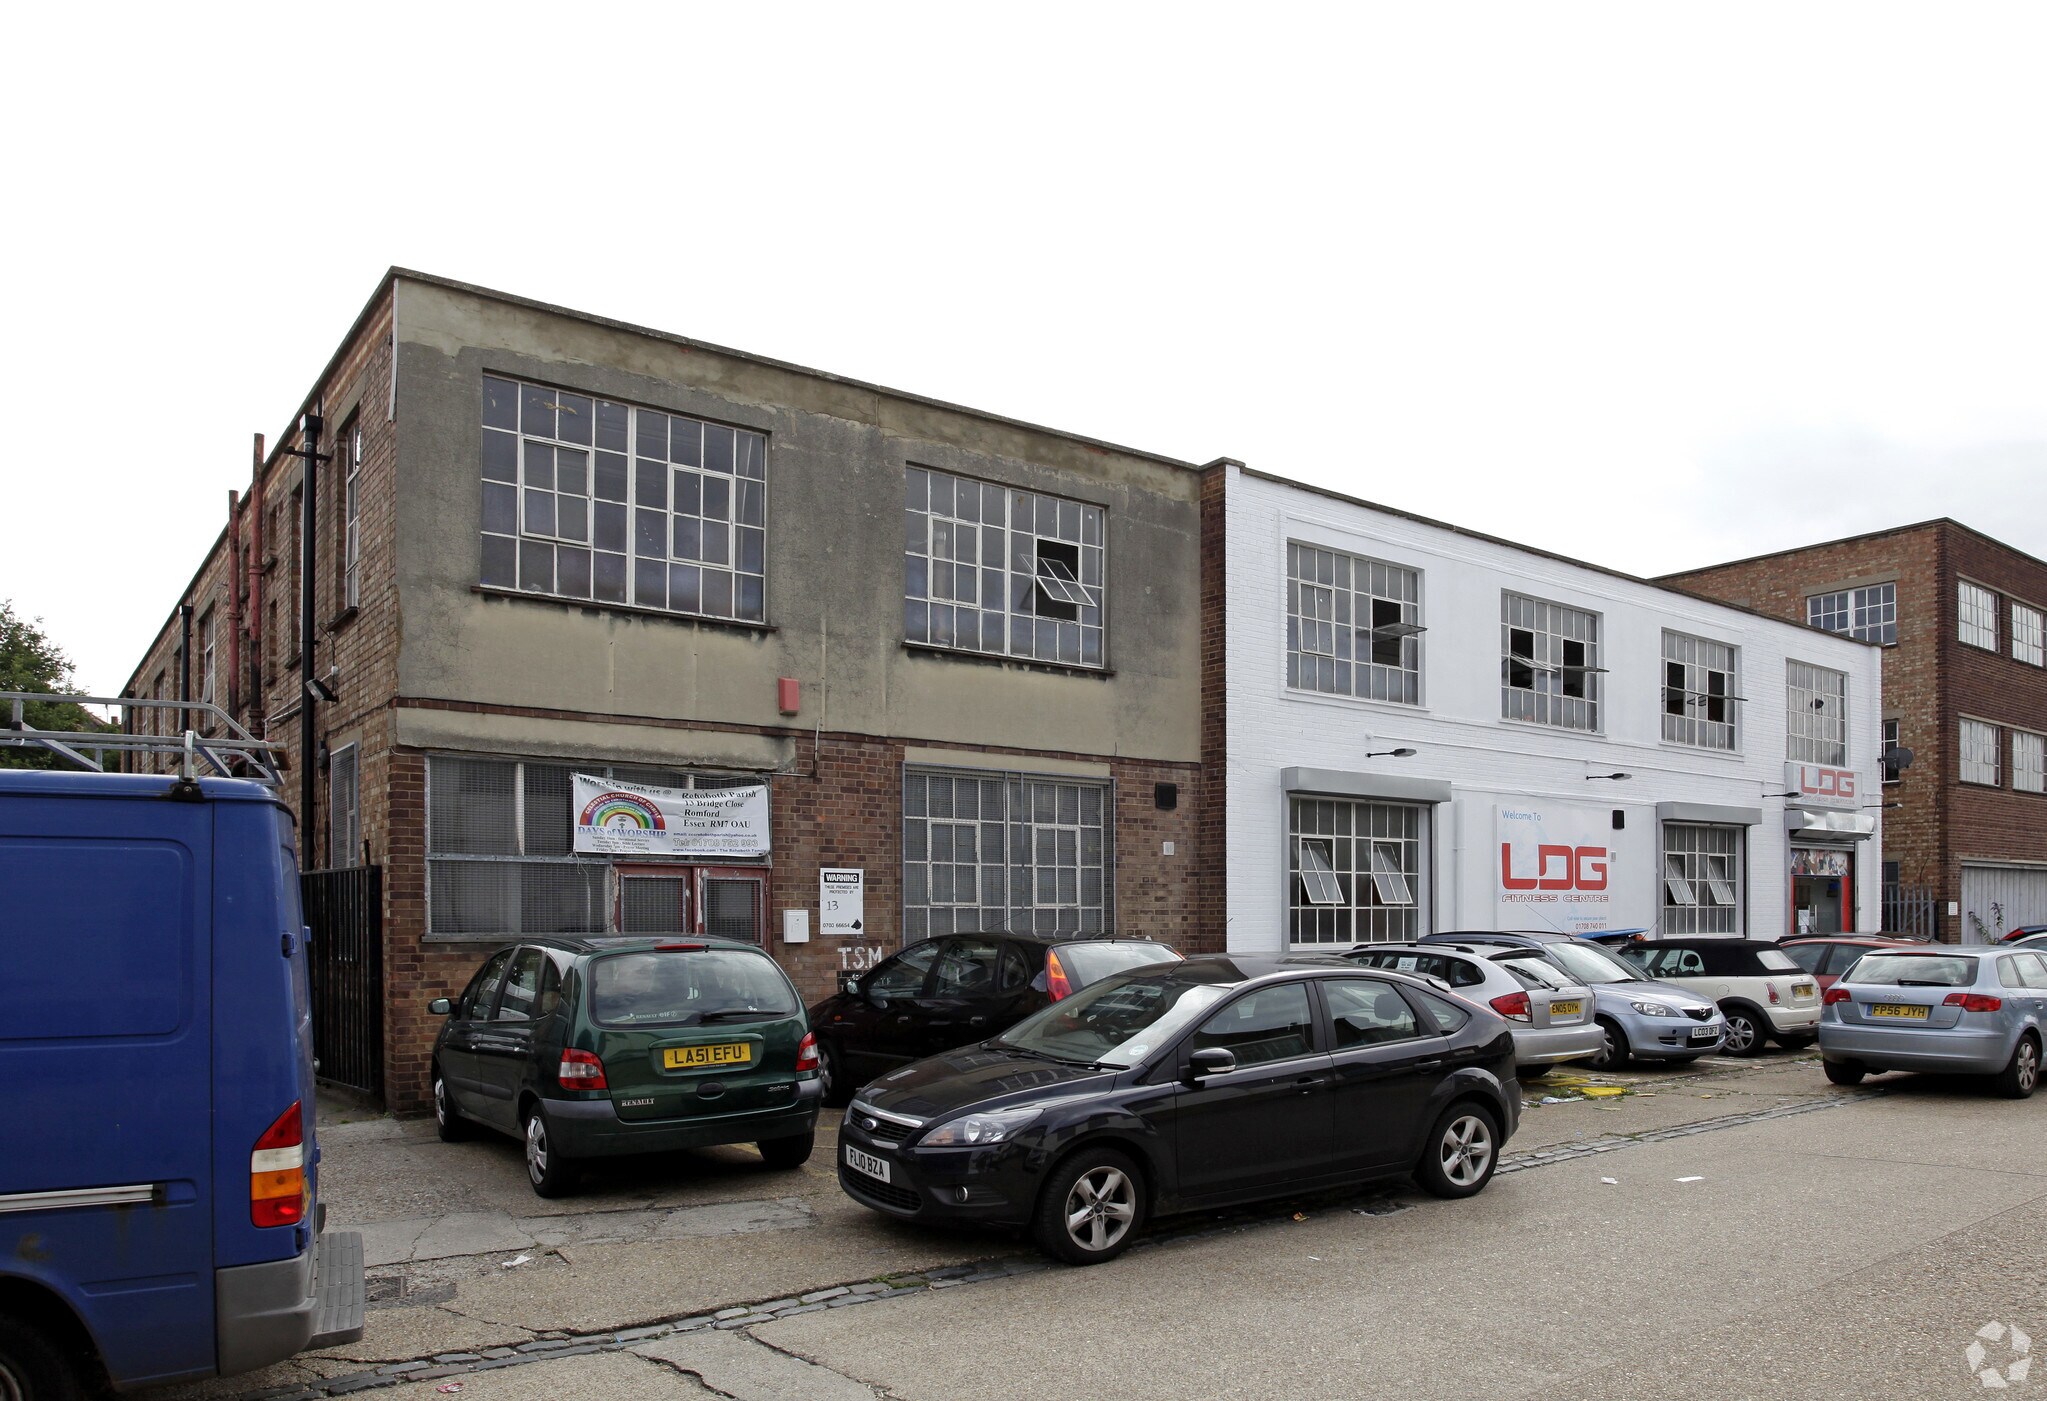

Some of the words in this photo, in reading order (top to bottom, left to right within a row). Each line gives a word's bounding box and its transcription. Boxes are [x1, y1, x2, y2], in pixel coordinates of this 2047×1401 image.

[580, 777, 622, 792] Worship
[625, 785, 646, 794] with
[1801, 767, 1854, 797] LDG
[728, 790, 756, 798] Parish
[585, 794, 610, 814] CELESTIAL
[638, 796, 646, 804] OF
[646, 802, 661, 818] CHRIST
[684, 809, 720, 817] Romford
[1502, 810, 1532, 821] Welcome
[1533, 812, 1542, 821] To
[710, 820, 729, 828] RM7
[578, 827, 605, 835] DAYS
[617, 829, 667, 838] WORSHIP
[1502, 843, 1607, 891] LDG
[826, 874, 857, 882] WARNING
[1502, 894, 1558, 902] FITNESS
[826, 900, 839, 910] 13
[1552, 1004, 1567, 1013] EN05
[1873, 1006, 1900, 1015] FP56
[1904, 1007, 1925, 1016] JYH
[674, 1048, 710, 1064] LA51
[714, 1046, 742, 1060] EFU
[621, 1098, 655, 1106] RENAULT
[850, 1149, 865, 1169] FL10
[867, 1157, 884, 1177] BZA
